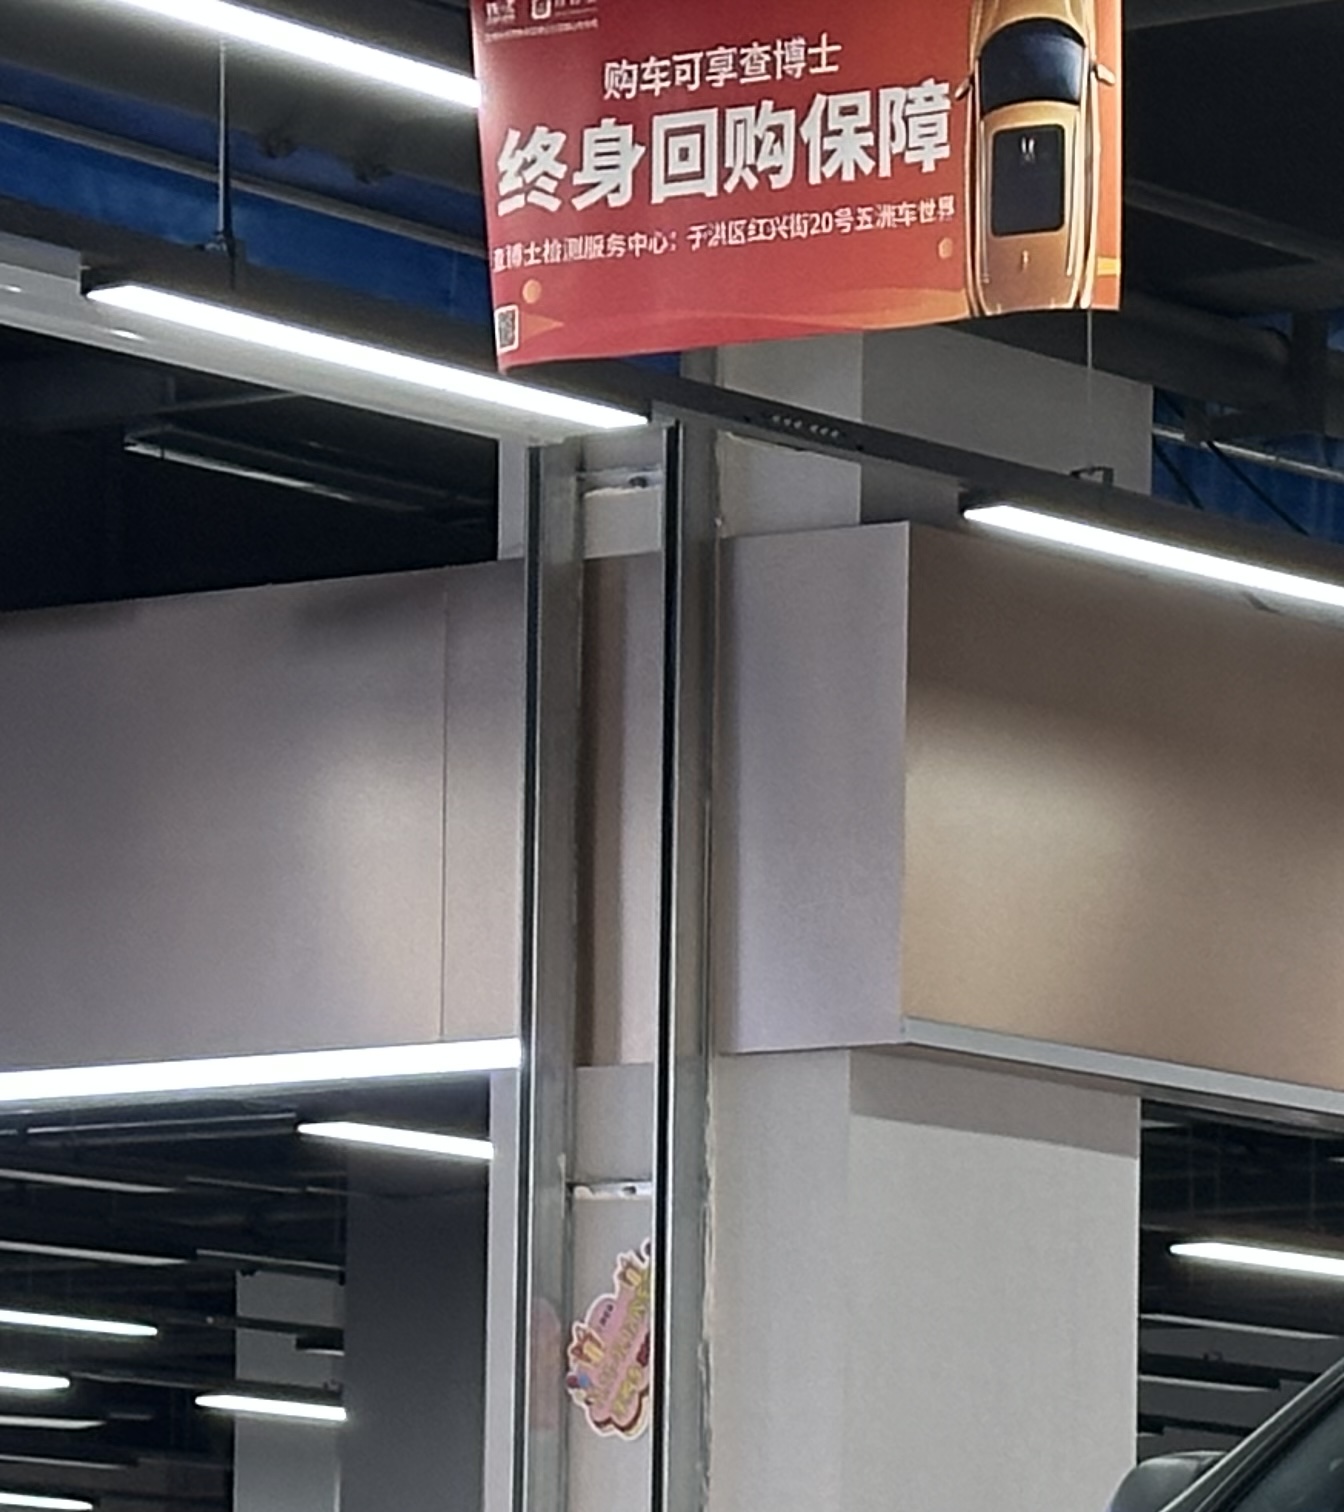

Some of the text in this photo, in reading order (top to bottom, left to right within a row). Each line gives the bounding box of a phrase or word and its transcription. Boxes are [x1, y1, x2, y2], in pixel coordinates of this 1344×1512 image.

[603, 33, 843, 100] 购车可享查博士
[496, 78, 952, 217] 终身回购保障
